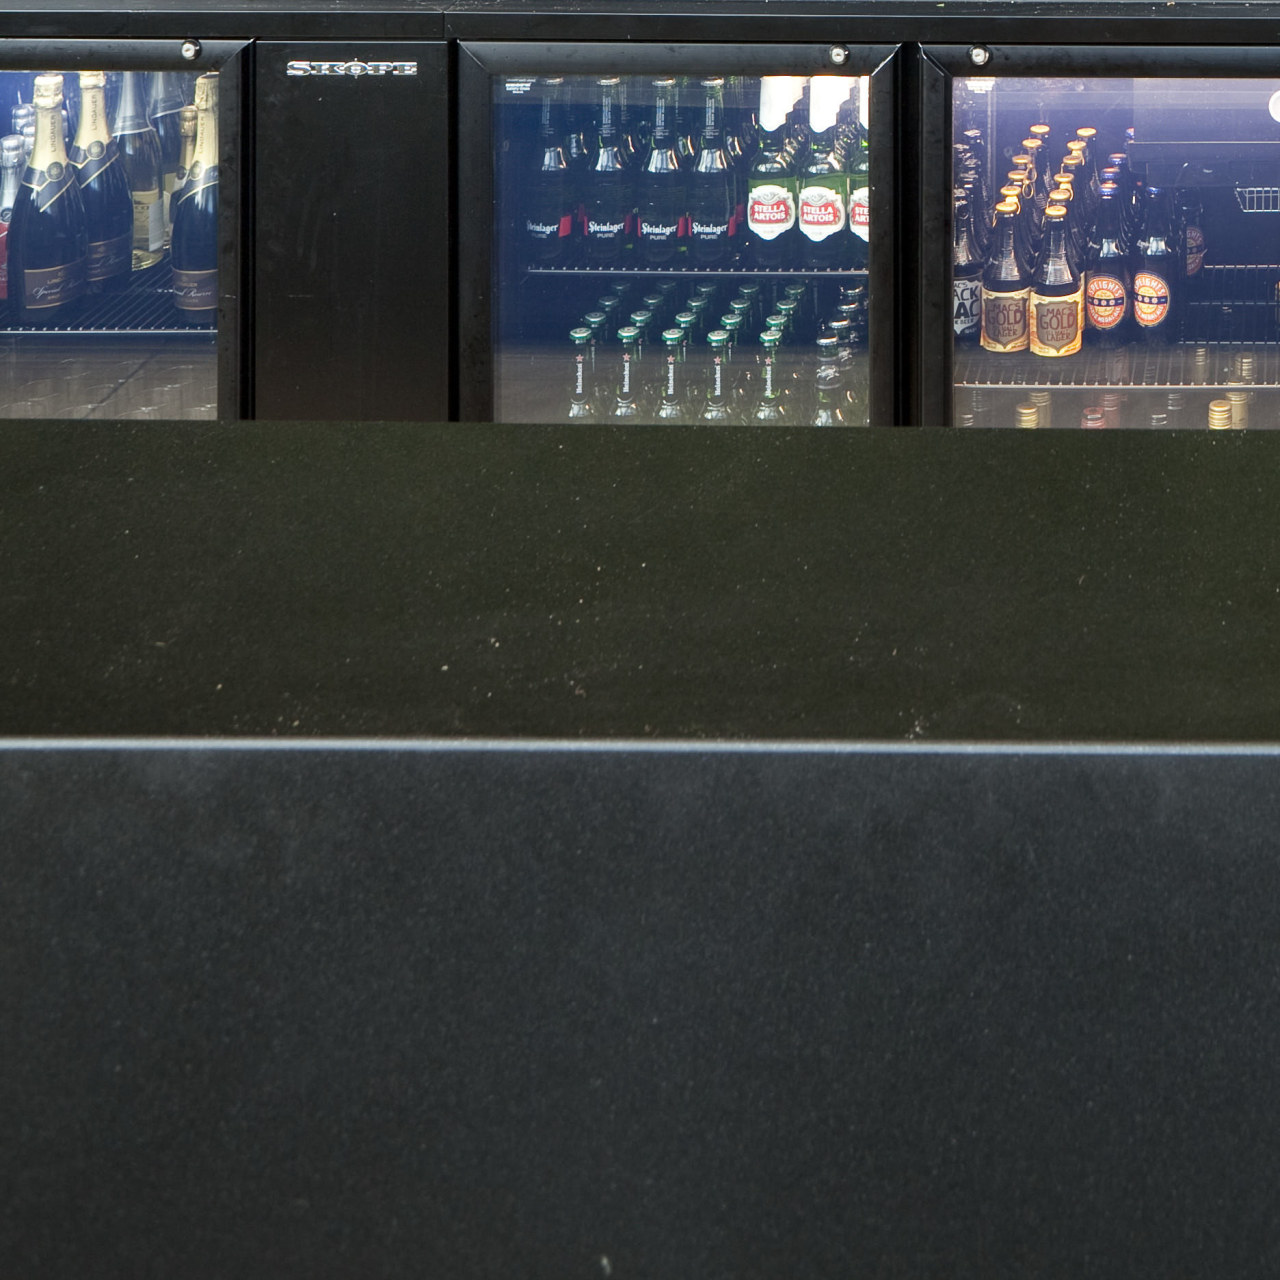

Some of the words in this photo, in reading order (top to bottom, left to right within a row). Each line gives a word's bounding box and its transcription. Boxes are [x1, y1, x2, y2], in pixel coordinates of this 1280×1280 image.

[286, 58, 418, 77] SKOPE
[753, 204, 786, 212] STELLA
[803, 205, 834, 214] STELLA
[753, 212, 786, 220] ARTOIS
[803, 213, 834, 222] ARTOIS
[588, 221, 625, 235] Steinlager
[641, 222, 678, 236] Steinlager
[692, 221, 728, 235] Steinlager
